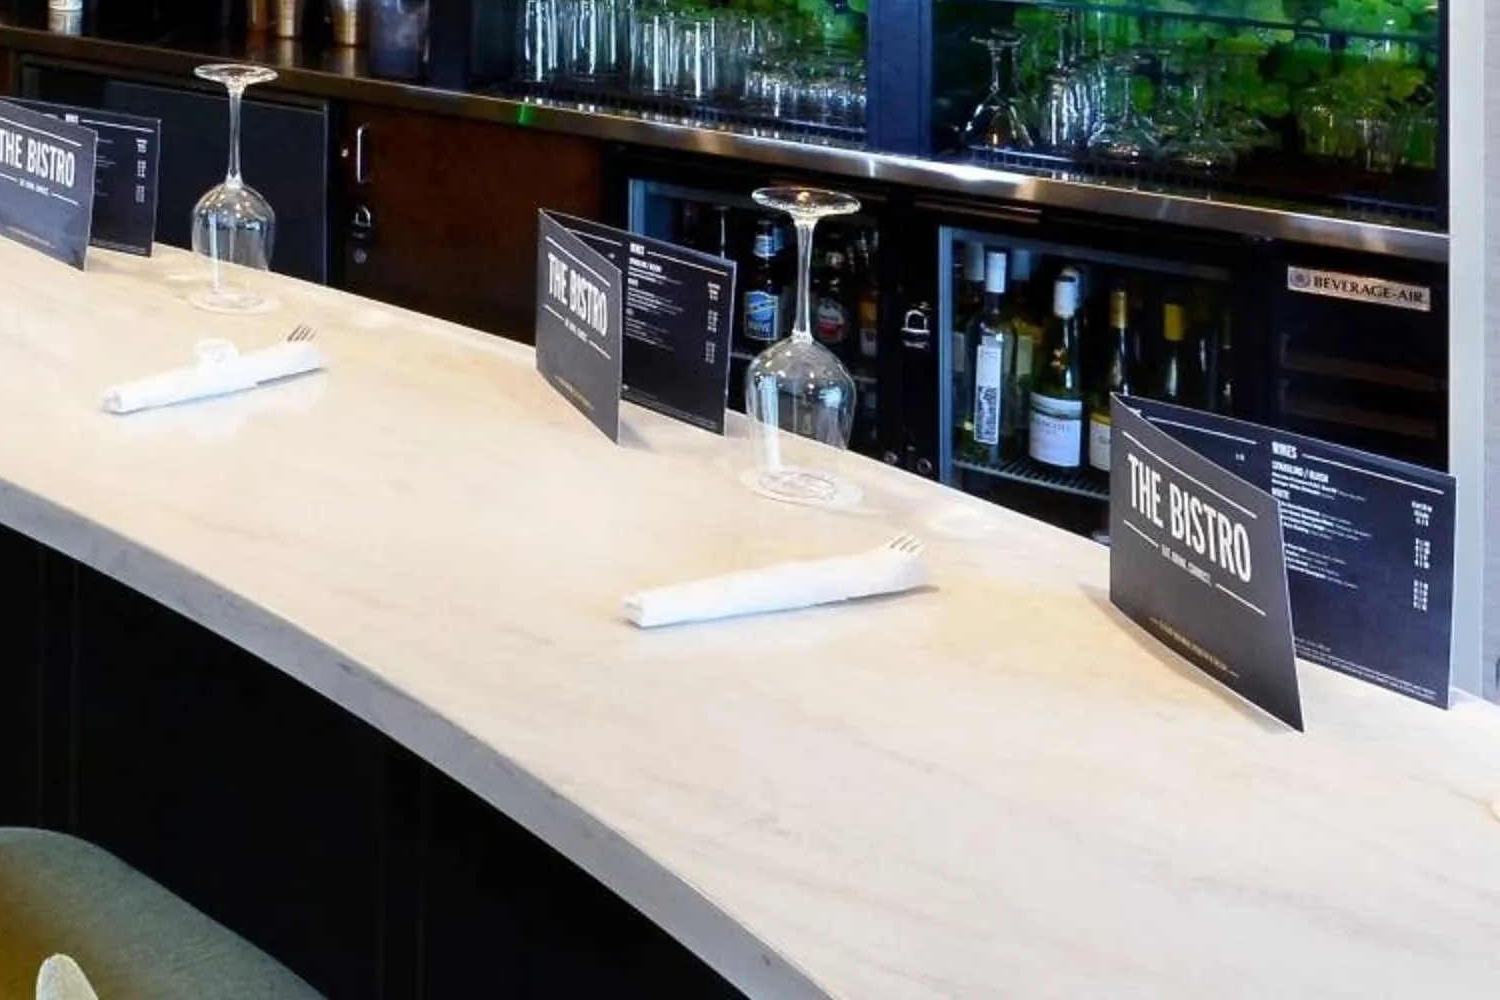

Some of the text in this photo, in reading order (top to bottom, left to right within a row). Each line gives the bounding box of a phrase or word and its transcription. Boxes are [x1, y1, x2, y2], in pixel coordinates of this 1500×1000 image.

[26, 138, 76, 188] BISTRO
[548, 252, 569, 306] THE
[569, 269, 609, 337] BISTRO
[1313, 275, 1424, 303] BEVERAGE-AIR
[1126, 453, 1163, 529] THE
[1169, 482, 1252, 584] BISTRO
